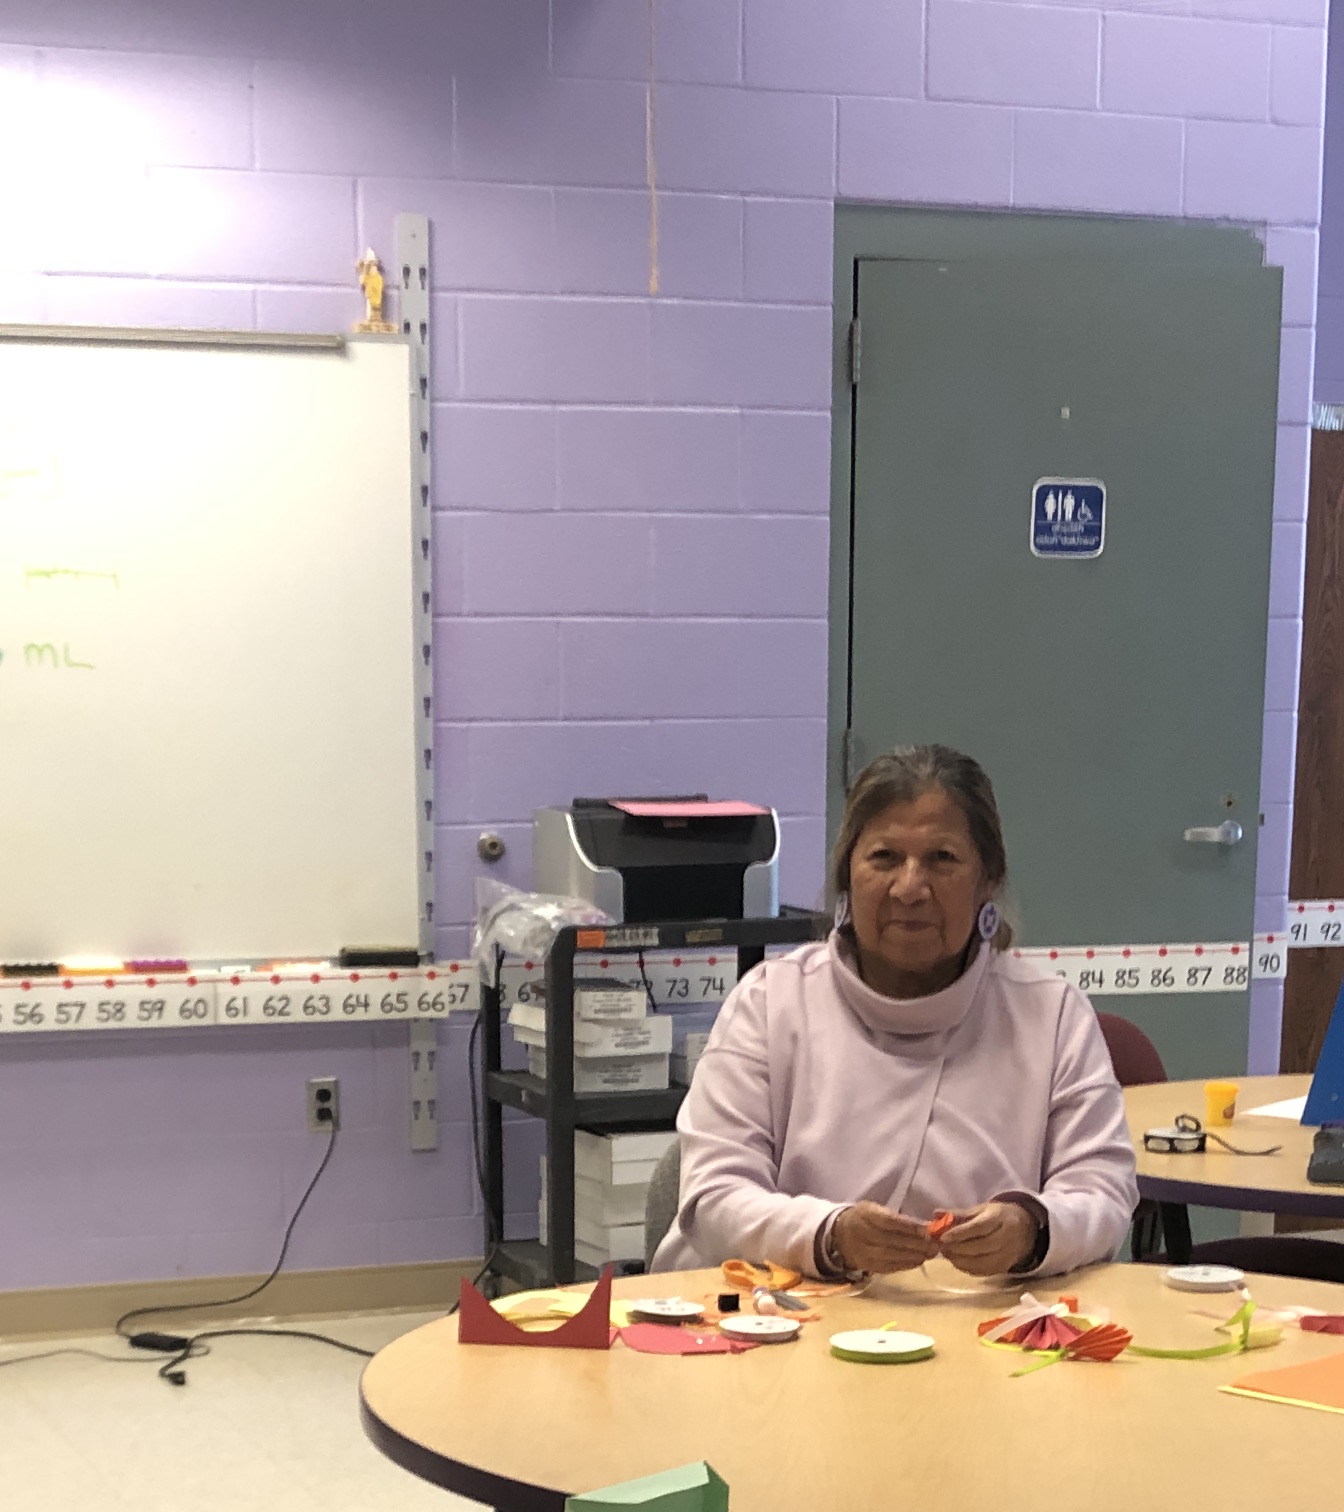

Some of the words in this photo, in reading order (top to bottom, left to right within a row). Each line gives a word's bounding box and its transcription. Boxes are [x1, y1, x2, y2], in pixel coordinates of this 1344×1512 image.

[1289, 922, 1309, 942] 91
[1319, 921, 1343, 942] 92
[1078, 968, 1105, 991] 84
[1115, 967, 1141, 989] 85
[1150, 966, 1175, 988] 86
[1186, 965, 1213, 987] 87
[1223, 964, 1249, 986] 88
[1258, 953, 1281, 974] 90
[665, 978, 690, 999] 73
[699, 976, 726, 998] 74
[13, 1003, 45, 1026] 56
[55, 1002, 87, 1024] 57
[96, 1000, 127, 1023] 58
[137, 999, 166, 1021] 59
[179, 998, 209, 1020] 60
[225, 996, 248, 1018] 61
[262, 995, 292, 1018] 62
[302, 993, 332, 1017] 63
[342, 993, 370, 1016] 64
[380, 992, 409, 1015] 65
[417, 991, 447, 1014] 66
